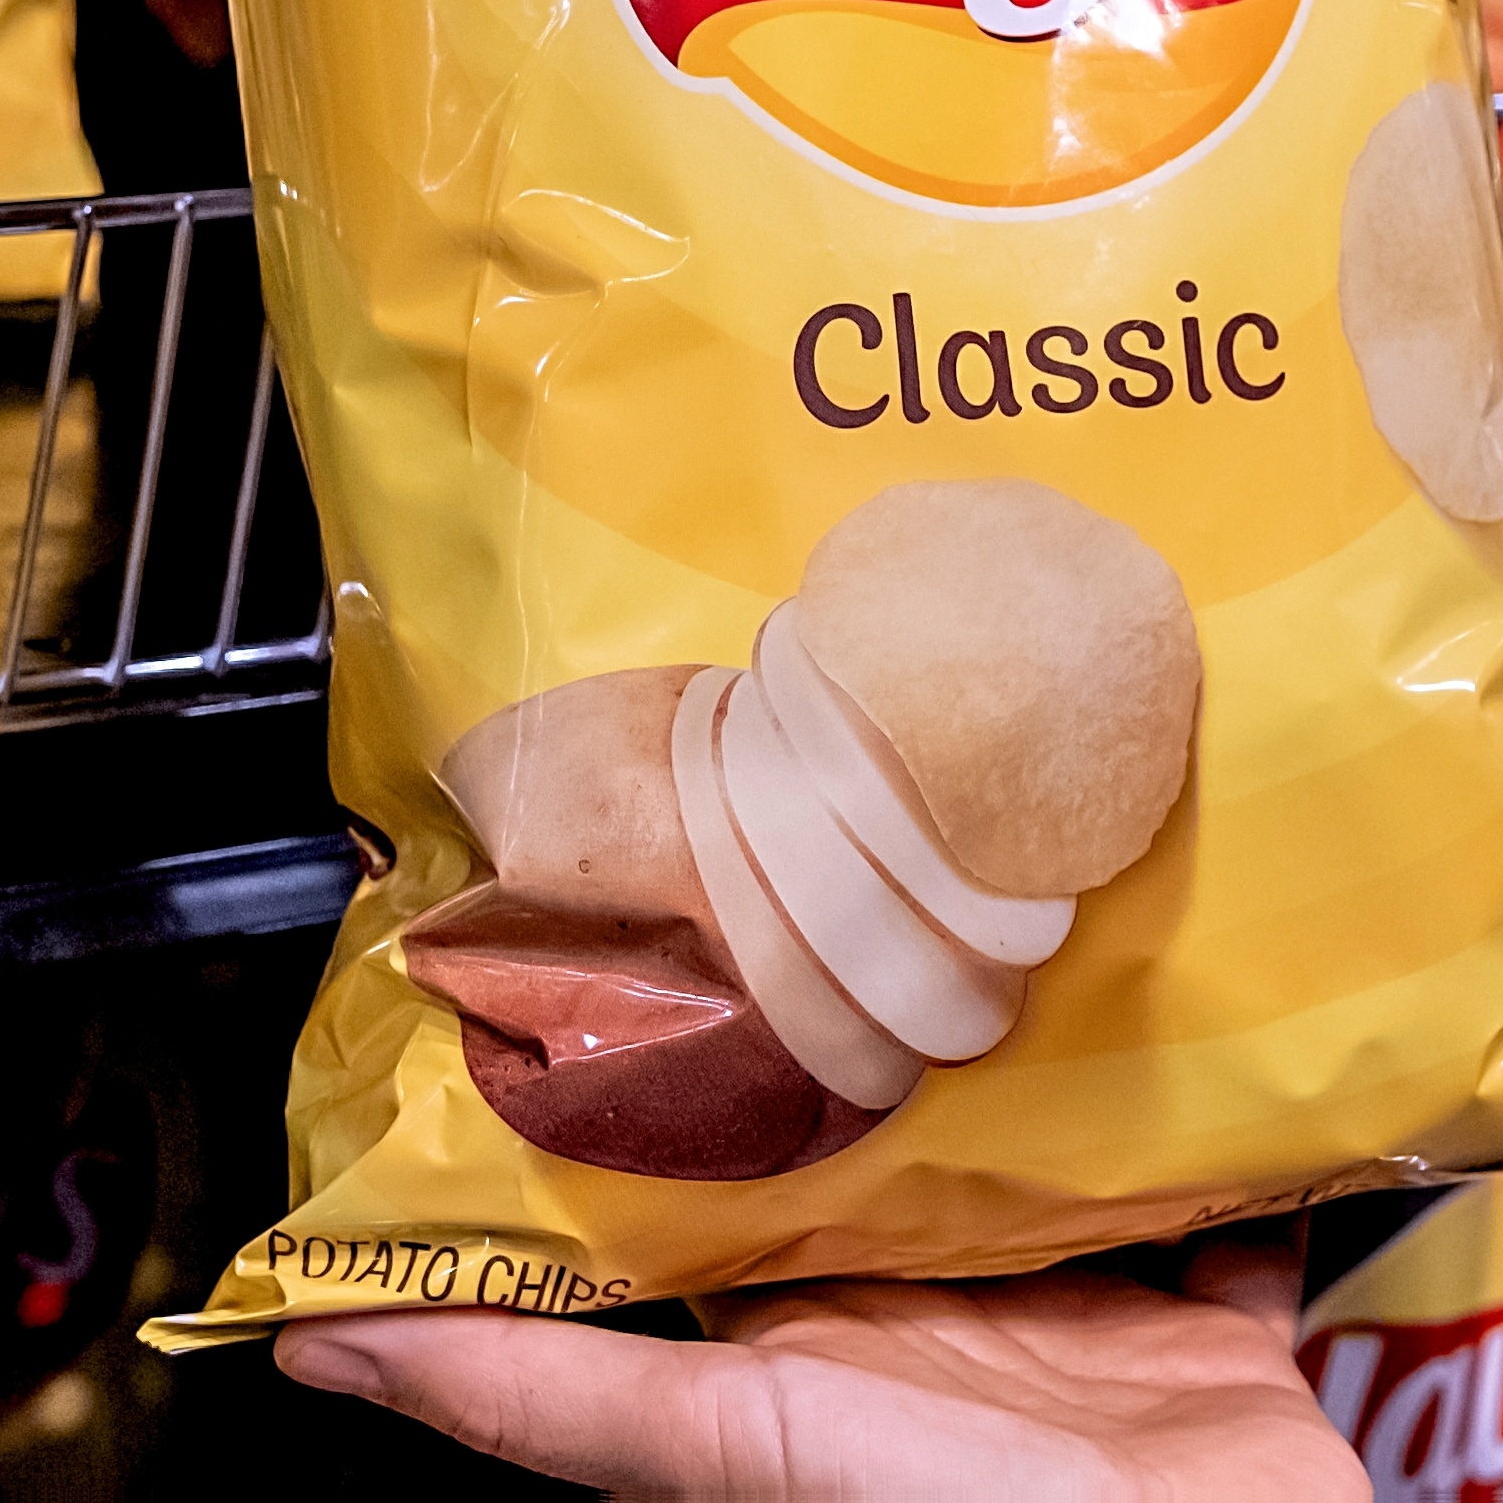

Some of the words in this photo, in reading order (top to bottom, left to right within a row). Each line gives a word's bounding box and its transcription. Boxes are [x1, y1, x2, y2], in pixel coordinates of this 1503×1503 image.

[793, 279, 1286, 429] Classic
[267, 1228, 460, 1302] POTATO
[477, 1254, 632, 1314] CHIPS
